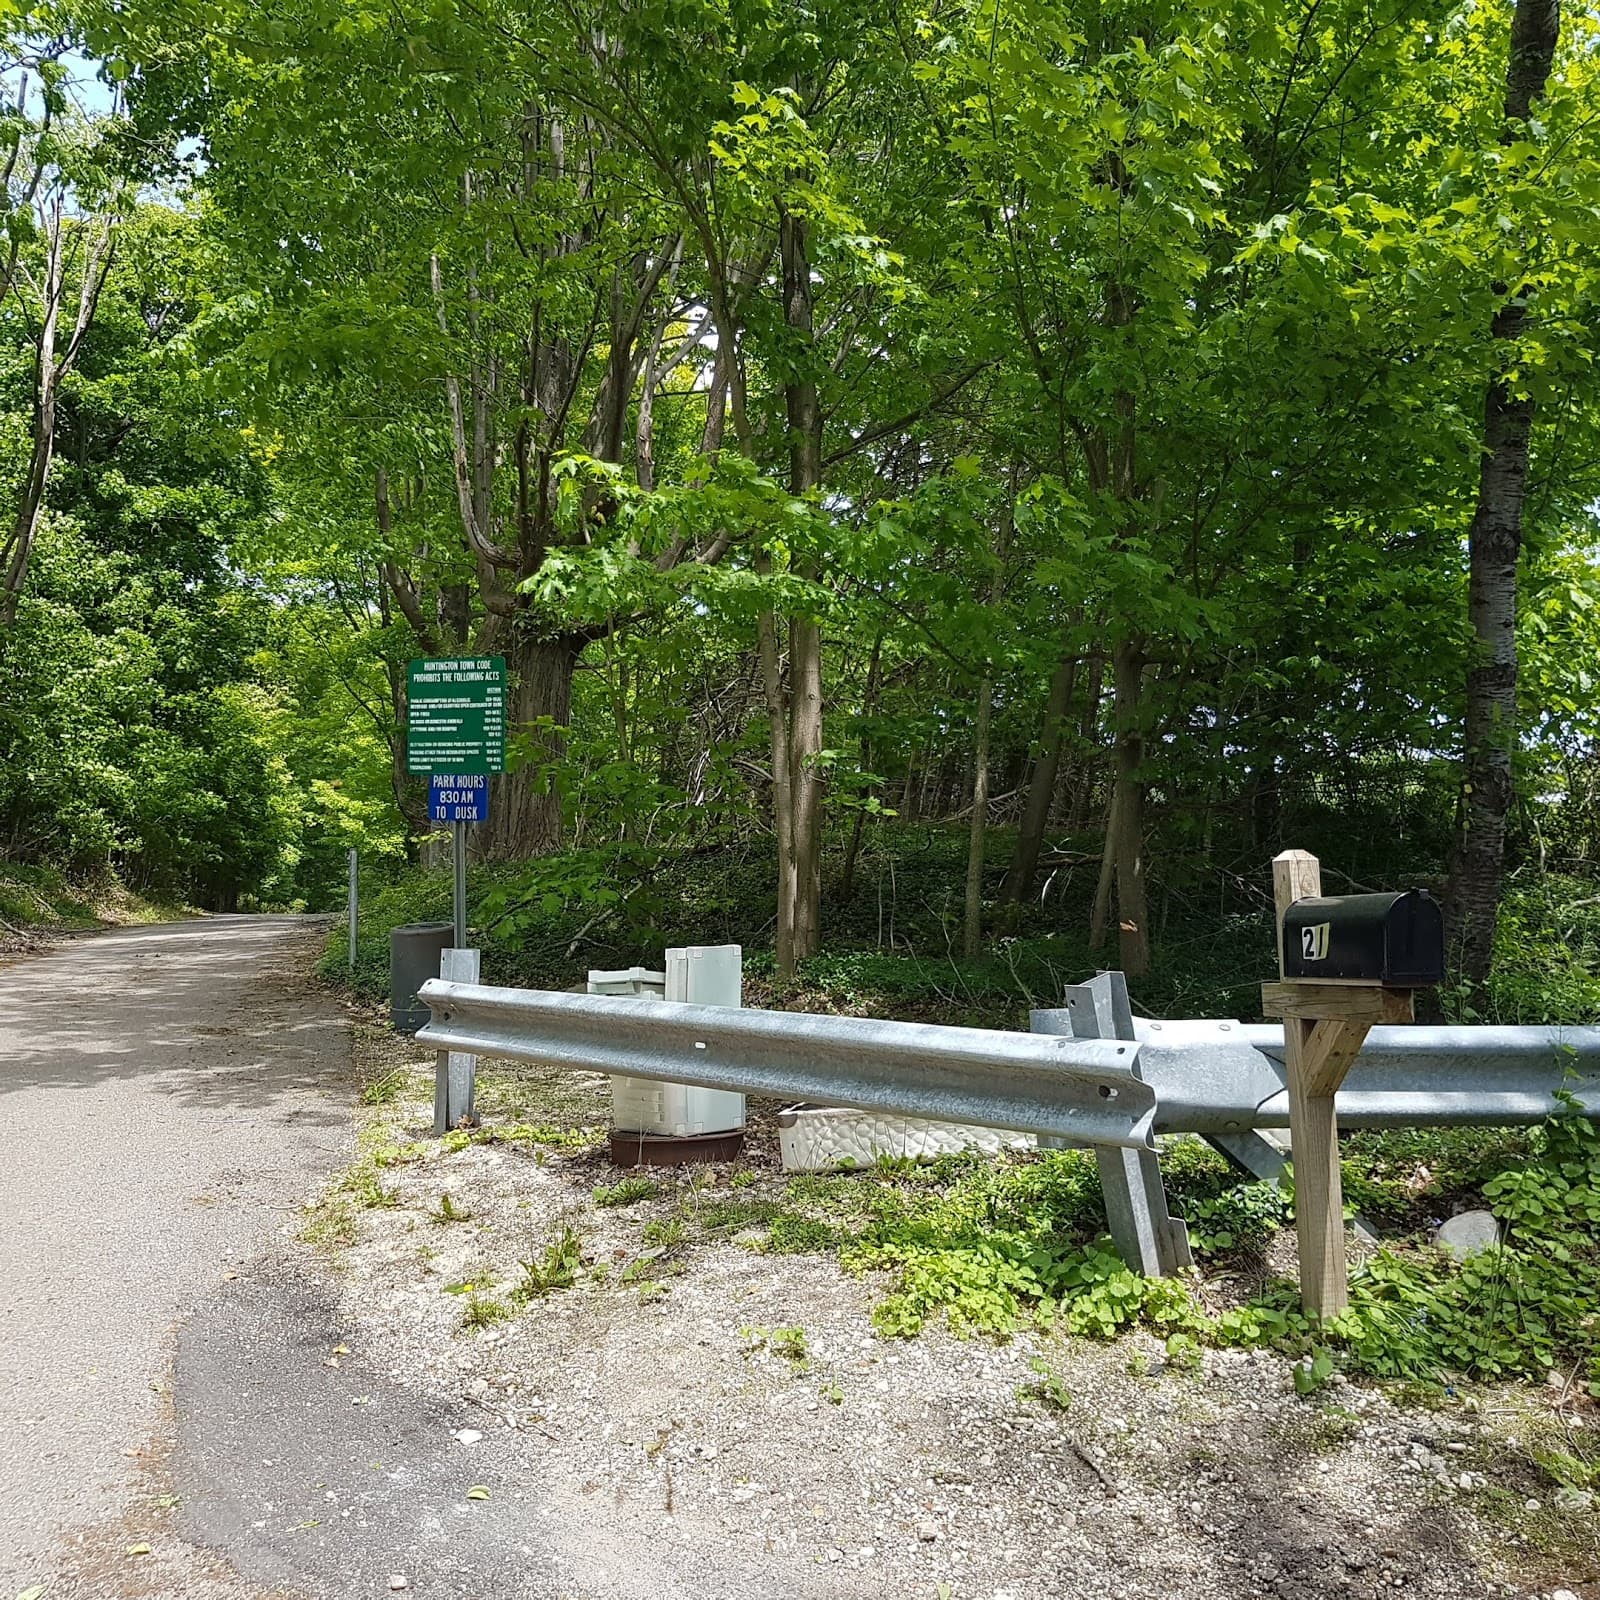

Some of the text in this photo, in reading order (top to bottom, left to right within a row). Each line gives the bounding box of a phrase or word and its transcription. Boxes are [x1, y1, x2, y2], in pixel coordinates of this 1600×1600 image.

[424, 660, 491, 671] HUNTINGTON TOWN CODE
[413, 671, 500, 682] PROHIBITS THE FOLLOWING ACTS
[433, 774, 485, 789] PARK HOURS
[460, 790, 474, 803] AM
[435, 806, 478, 819] TO DUSK
[1303, 926, 1324, 958] 21
